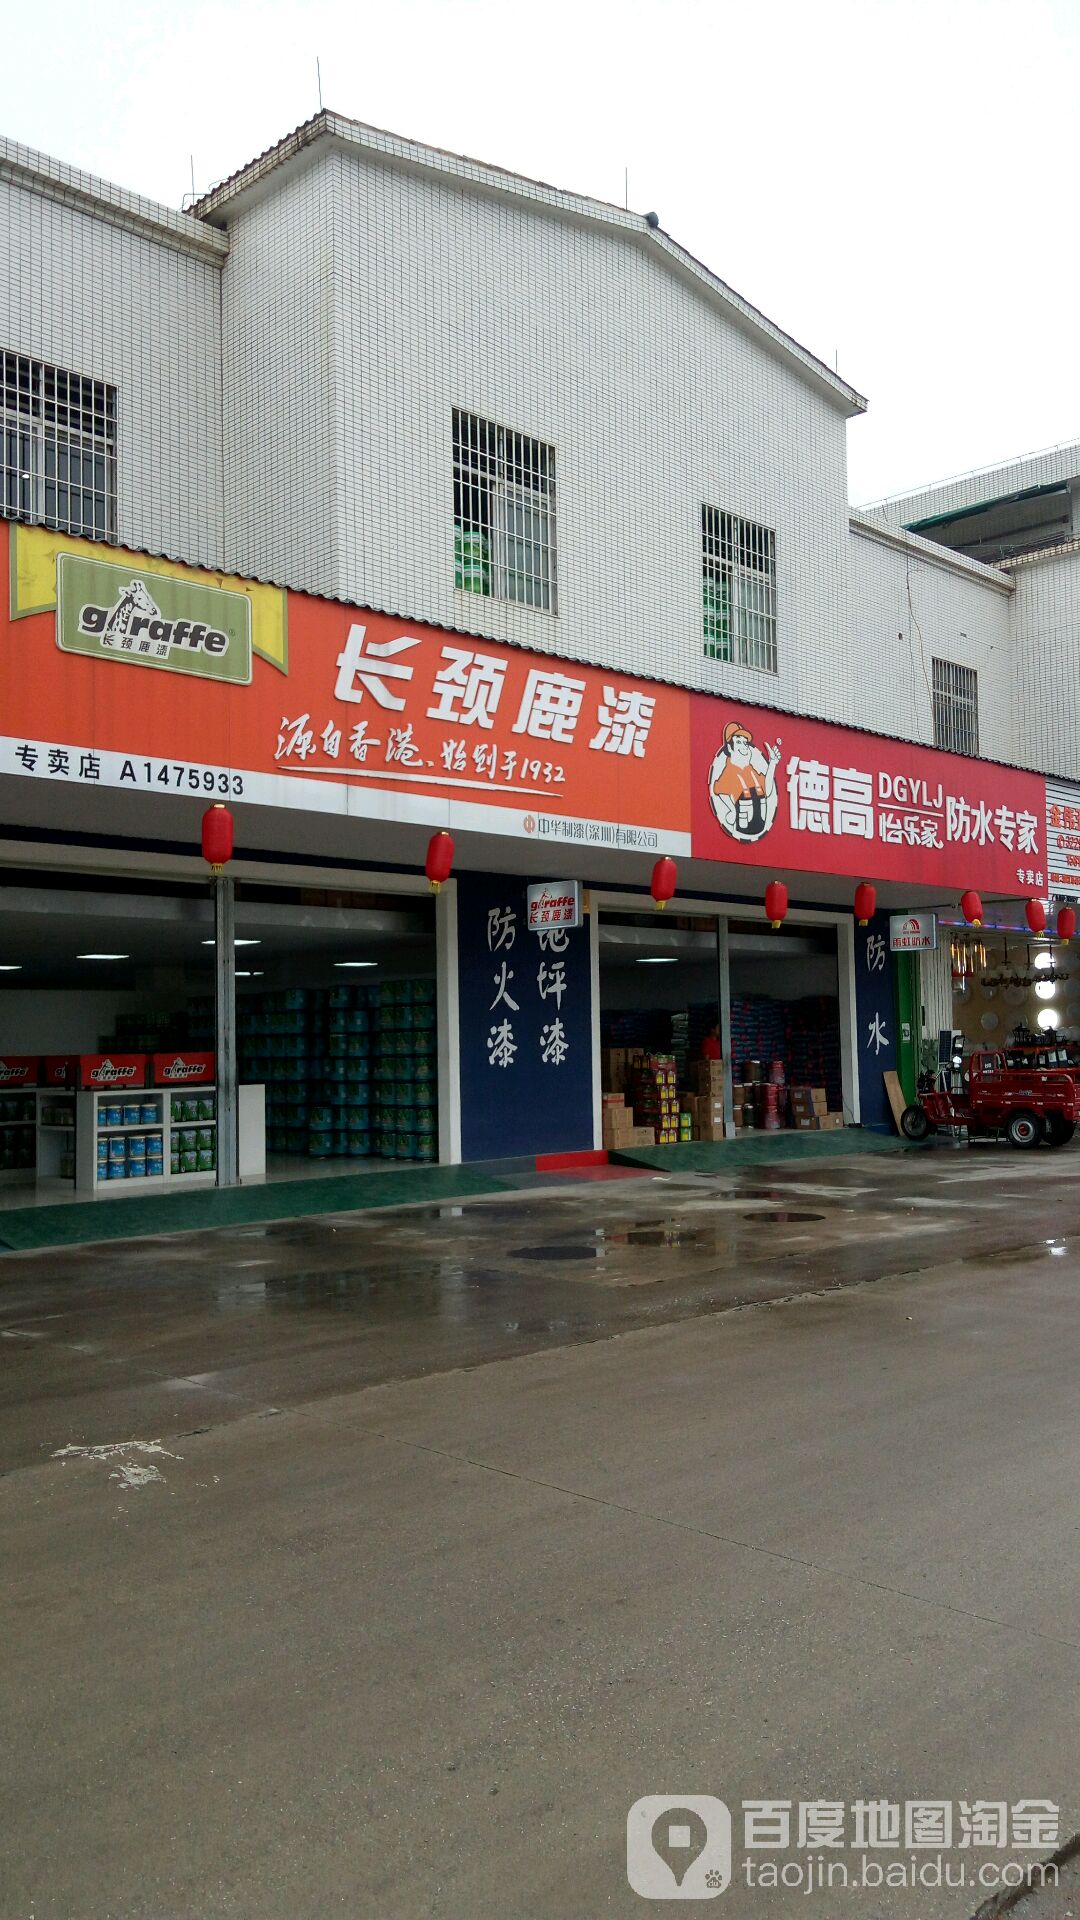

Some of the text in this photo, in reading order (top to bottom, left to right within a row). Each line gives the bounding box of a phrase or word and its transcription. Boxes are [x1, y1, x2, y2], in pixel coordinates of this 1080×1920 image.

[102, 633, 169, 657] 长颈鹿漆
[334, 624, 655, 757] 长颈鹿漆
[15, 744, 243, 795] 专卖店 A1475933
[878, 771, 943, 808] DGYLJ
[786, 756, 874, 839] 德高
[945, 795, 1039, 854] 防水专家
[878, 812, 944, 849] 怡乐家
[1016, 868, 1043, 886] 专卖店
[487, 906, 519, 1068] 防火漆
[867, 935, 889, 1055] 防水
